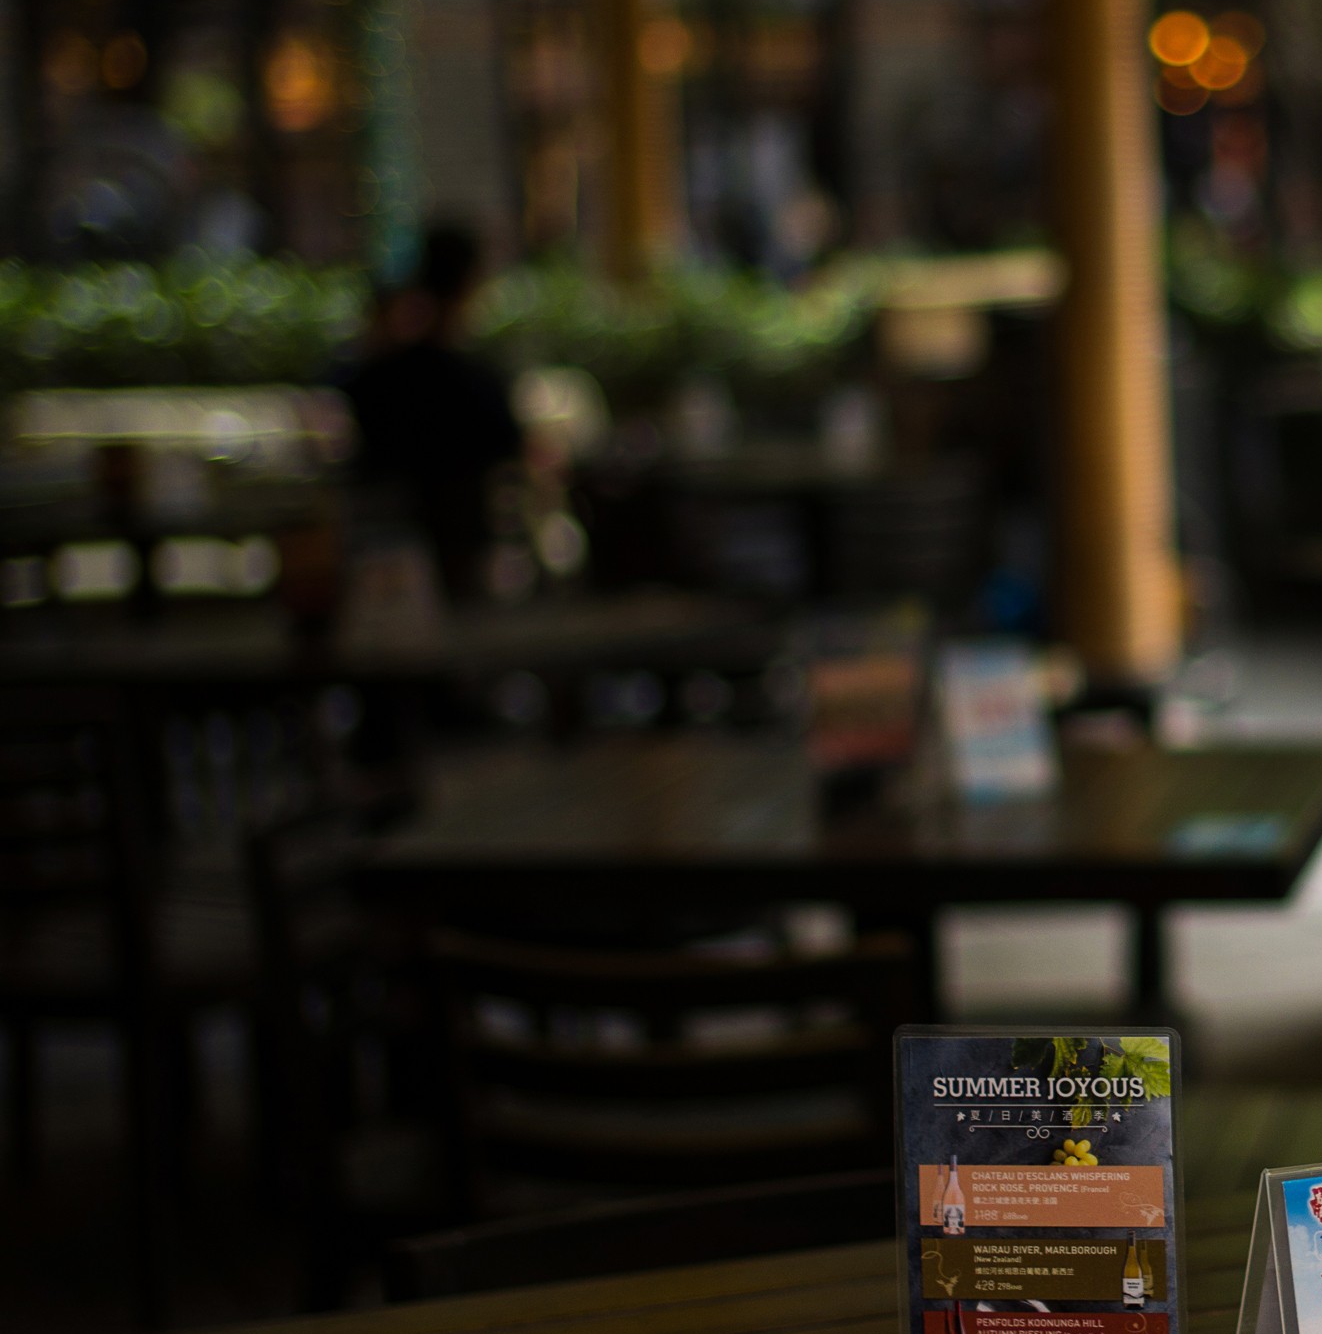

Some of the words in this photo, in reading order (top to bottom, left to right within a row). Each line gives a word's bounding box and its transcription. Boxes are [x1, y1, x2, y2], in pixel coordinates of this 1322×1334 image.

[932, 1076, 1041, 1099] SUMMER
[1046, 1076, 1145, 1100] JOYOUS
[971, 1171, 1015, 1181] CHATEAU
[1070, 1172, 1131, 1182] WHISPERING
[971, 1183, 998, 1193] ROCK
[999, 1183, 1027, 1194] ROSE,
[1028, 1183, 1079, 1194] PROVENCE
[972, 1245, 1010, 1255] WAIRAU
[1012, 1245, 1043, 1256] RIVER,
[1044, 1245, 1118, 1255] MARLBOROUGH
[974, 1279, 996, 1291] 428
[976, 1318, 1026, 1328] PENFOLDS
[1027, 1318, 1081, 1328] KOONUNGA
[1082, 1318, 1105, 1329] HILL
